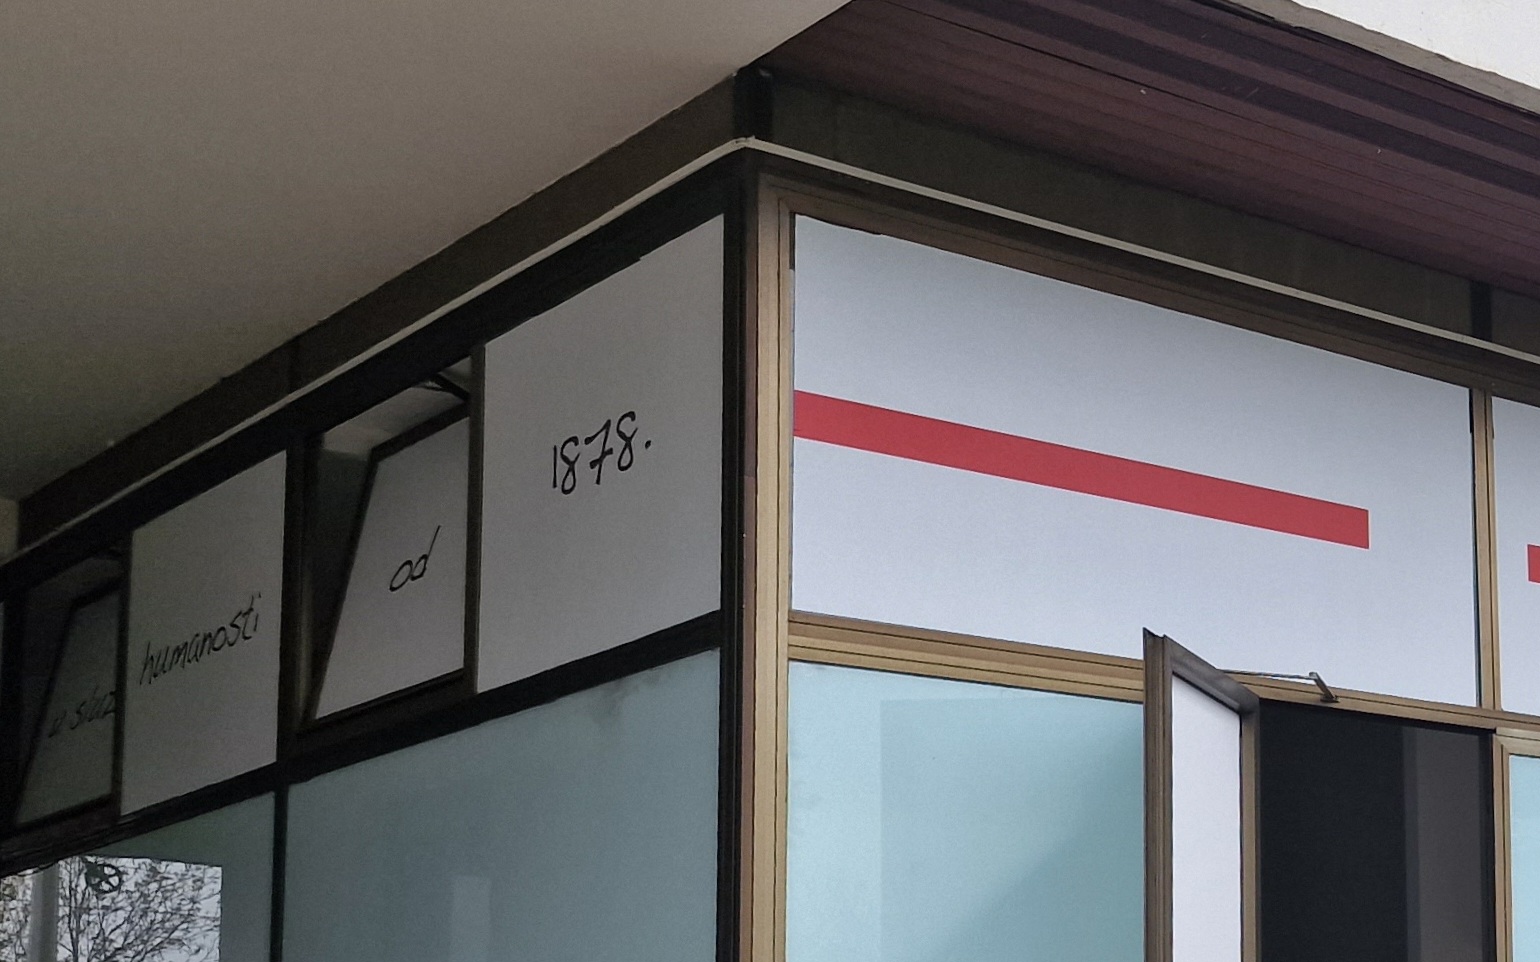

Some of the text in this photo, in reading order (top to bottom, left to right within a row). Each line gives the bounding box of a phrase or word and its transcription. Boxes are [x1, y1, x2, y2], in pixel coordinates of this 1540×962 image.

[552, 411, 652, 494] 1878.
[389, 525, 441, 592] od
[139, 591, 262, 685] humanosti
